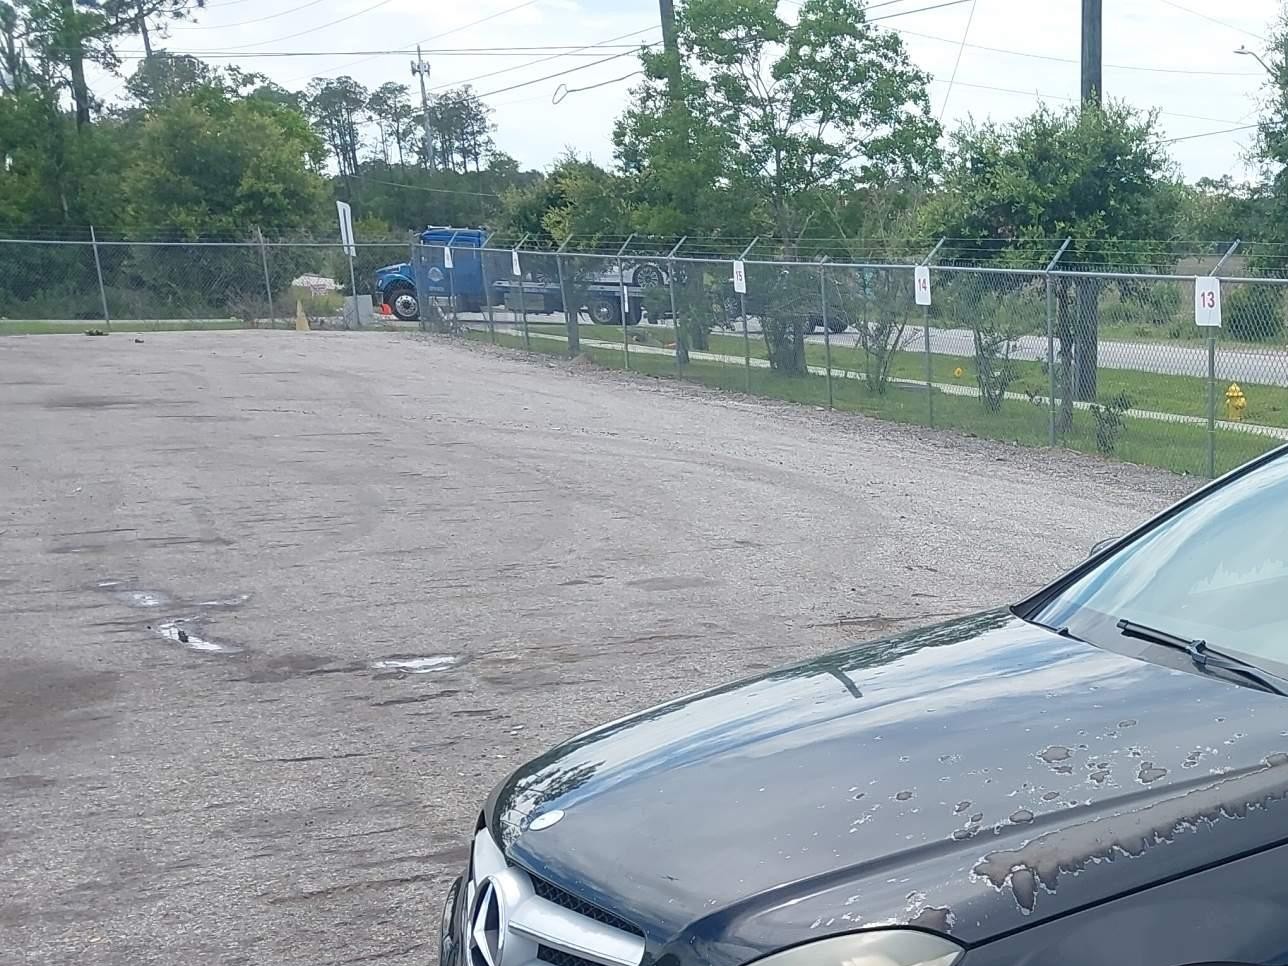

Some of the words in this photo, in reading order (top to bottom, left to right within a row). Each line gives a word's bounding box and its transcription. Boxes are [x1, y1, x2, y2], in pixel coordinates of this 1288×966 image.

[736, 270, 743, 282] 15
[918, 278, 928, 292] 14
[1200, 291, 1215, 309] 13
